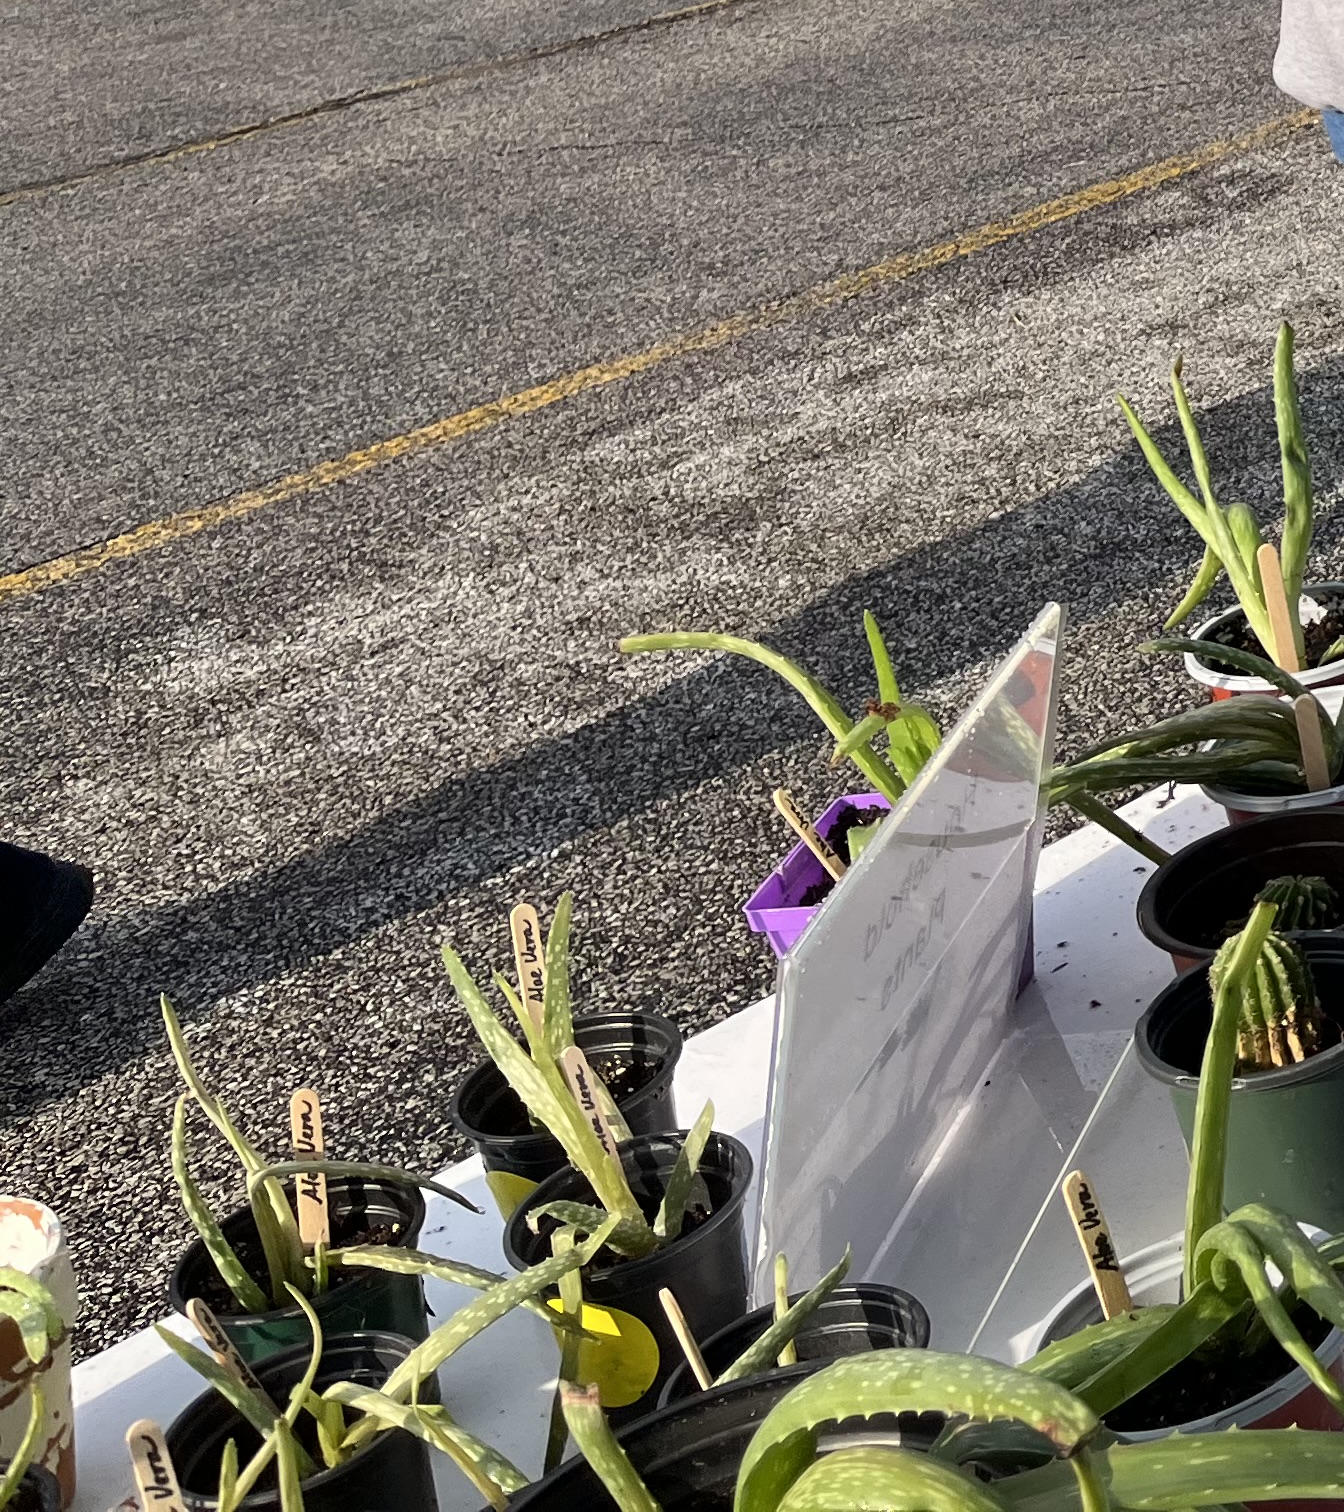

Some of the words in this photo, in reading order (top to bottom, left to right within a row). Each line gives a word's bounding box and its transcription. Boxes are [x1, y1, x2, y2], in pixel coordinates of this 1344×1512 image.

[520, 918, 538, 963] Vera
[527, 967, 545, 1003] Aloe
[296, 1099, 316, 1153] Vera
[1078, 1182, 1101, 1231] Vera
[1092, 1231, 1119, 1272] Aloe
[141, 1434, 174, 1500] Vera
